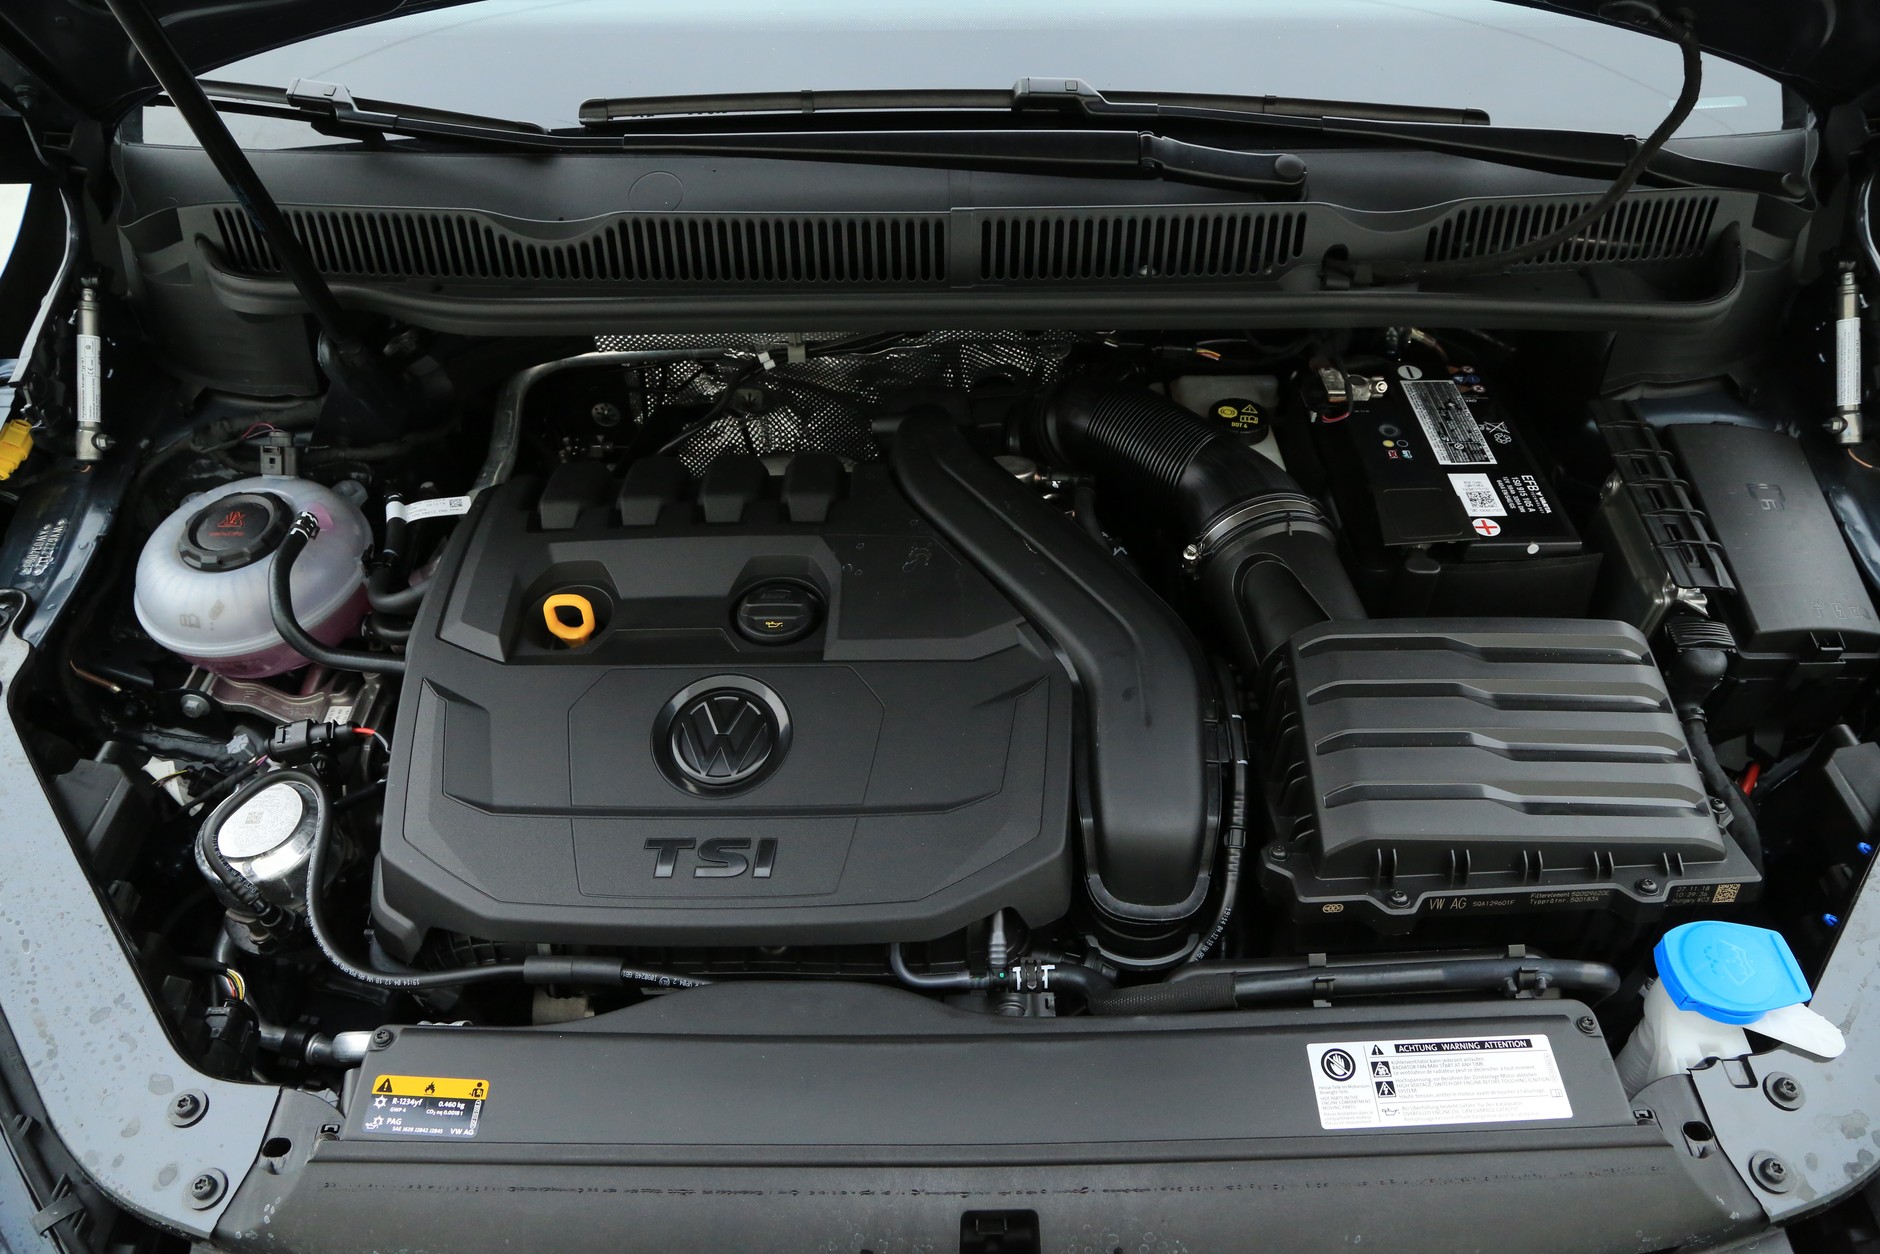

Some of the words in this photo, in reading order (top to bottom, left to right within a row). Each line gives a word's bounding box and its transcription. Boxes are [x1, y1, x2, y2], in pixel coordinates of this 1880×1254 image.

[1521, 474, 1540, 492] EFB
[1516, 486, 1528, 497] 915
[643, 837, 779, 879] TSI
[1429, 898, 1446, 910] VW
[1449, 897, 1467, 910] AG
[1398, 1043, 1438, 1053] ACHTUNG
[1441, 1041, 1481, 1051] WARNING
[1484, 1040, 1527, 1049] ATTENTION
[391, 1097, 423, 1107] R-1234yf
[438, 1100, 457, 1109] 0.460
[457, 1102, 466, 1111] kg
[386, 1117, 403, 1126] PAG
[450, 1128, 463, 1136] VW
[463, 1128, 475, 1136] AG
